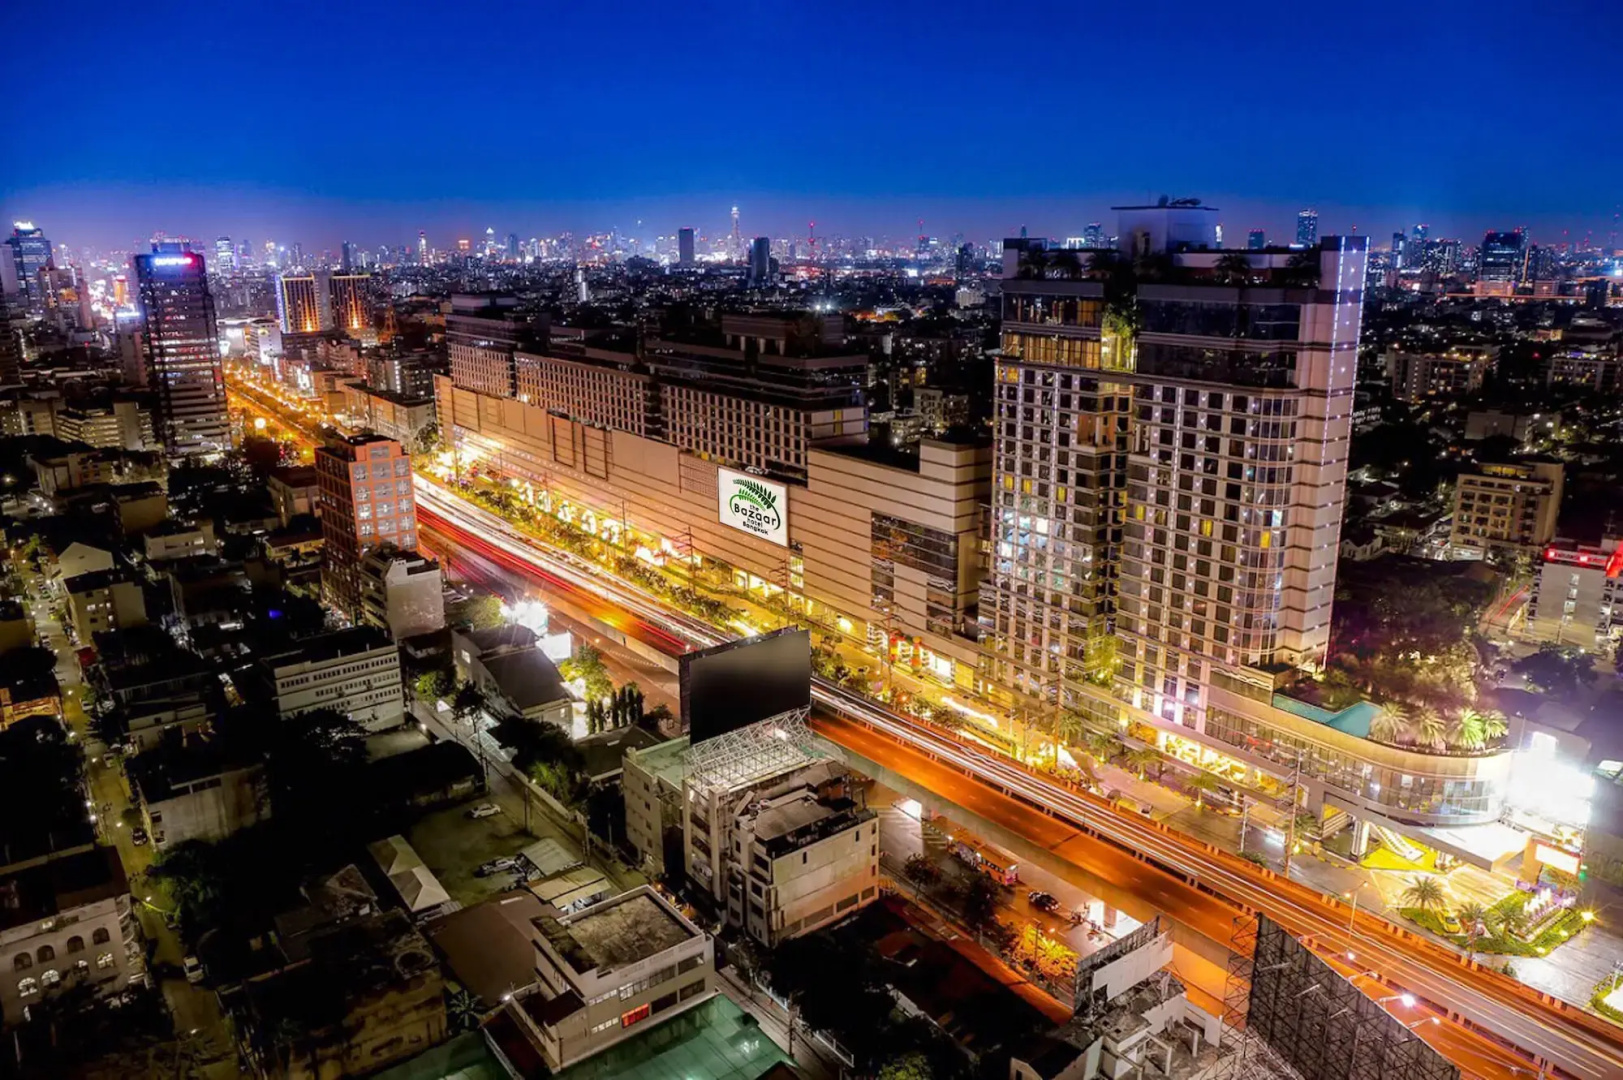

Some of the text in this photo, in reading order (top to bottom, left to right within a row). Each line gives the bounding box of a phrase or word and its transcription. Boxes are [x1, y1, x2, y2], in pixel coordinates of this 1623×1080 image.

[750, 504, 760, 512] the
[734, 503, 776, 526] Bazaar
[742, 521, 769, 535] Bangkok
[747, 518, 763, 527] hotel
